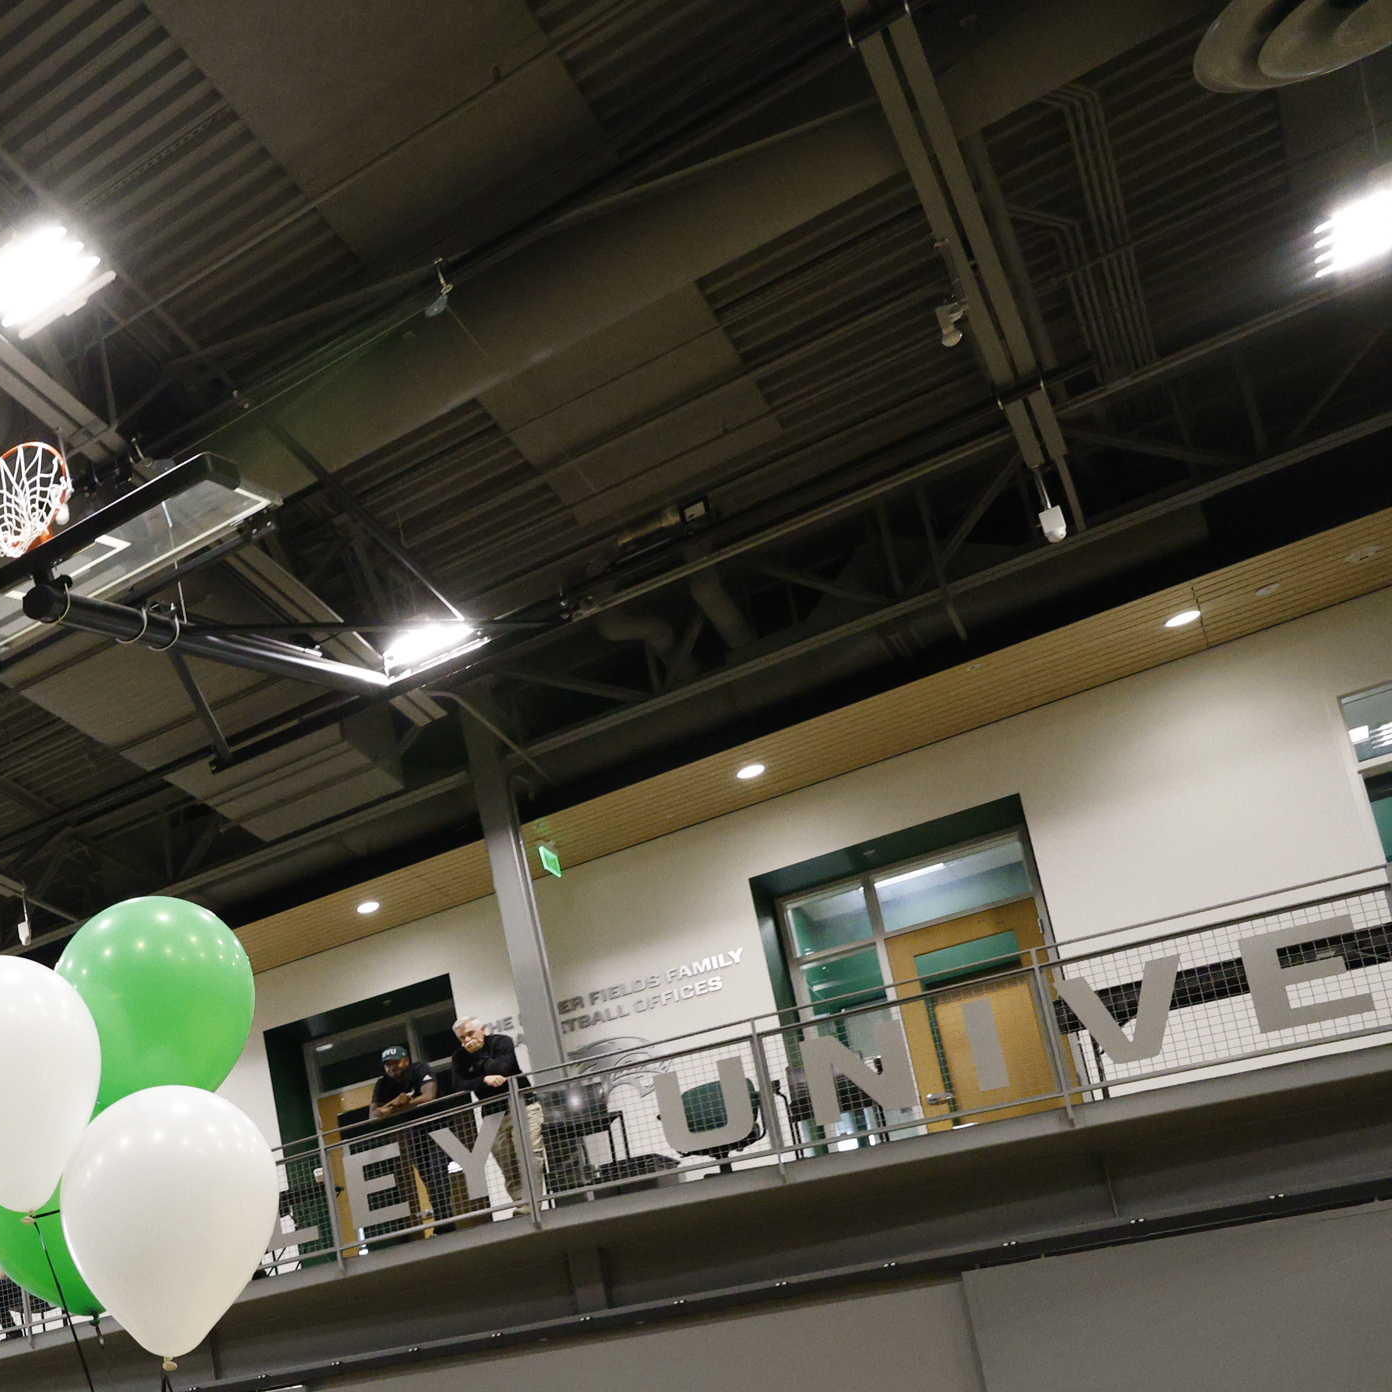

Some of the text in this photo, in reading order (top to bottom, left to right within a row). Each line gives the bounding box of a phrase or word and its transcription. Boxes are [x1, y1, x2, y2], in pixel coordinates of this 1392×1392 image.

[588, 972, 661, 1006] FIELDS
[666, 947, 744, 984] FAMILY
[635, 976, 724, 1013] OFFICES
[653, 913, 1375, 1152] UNIVE
